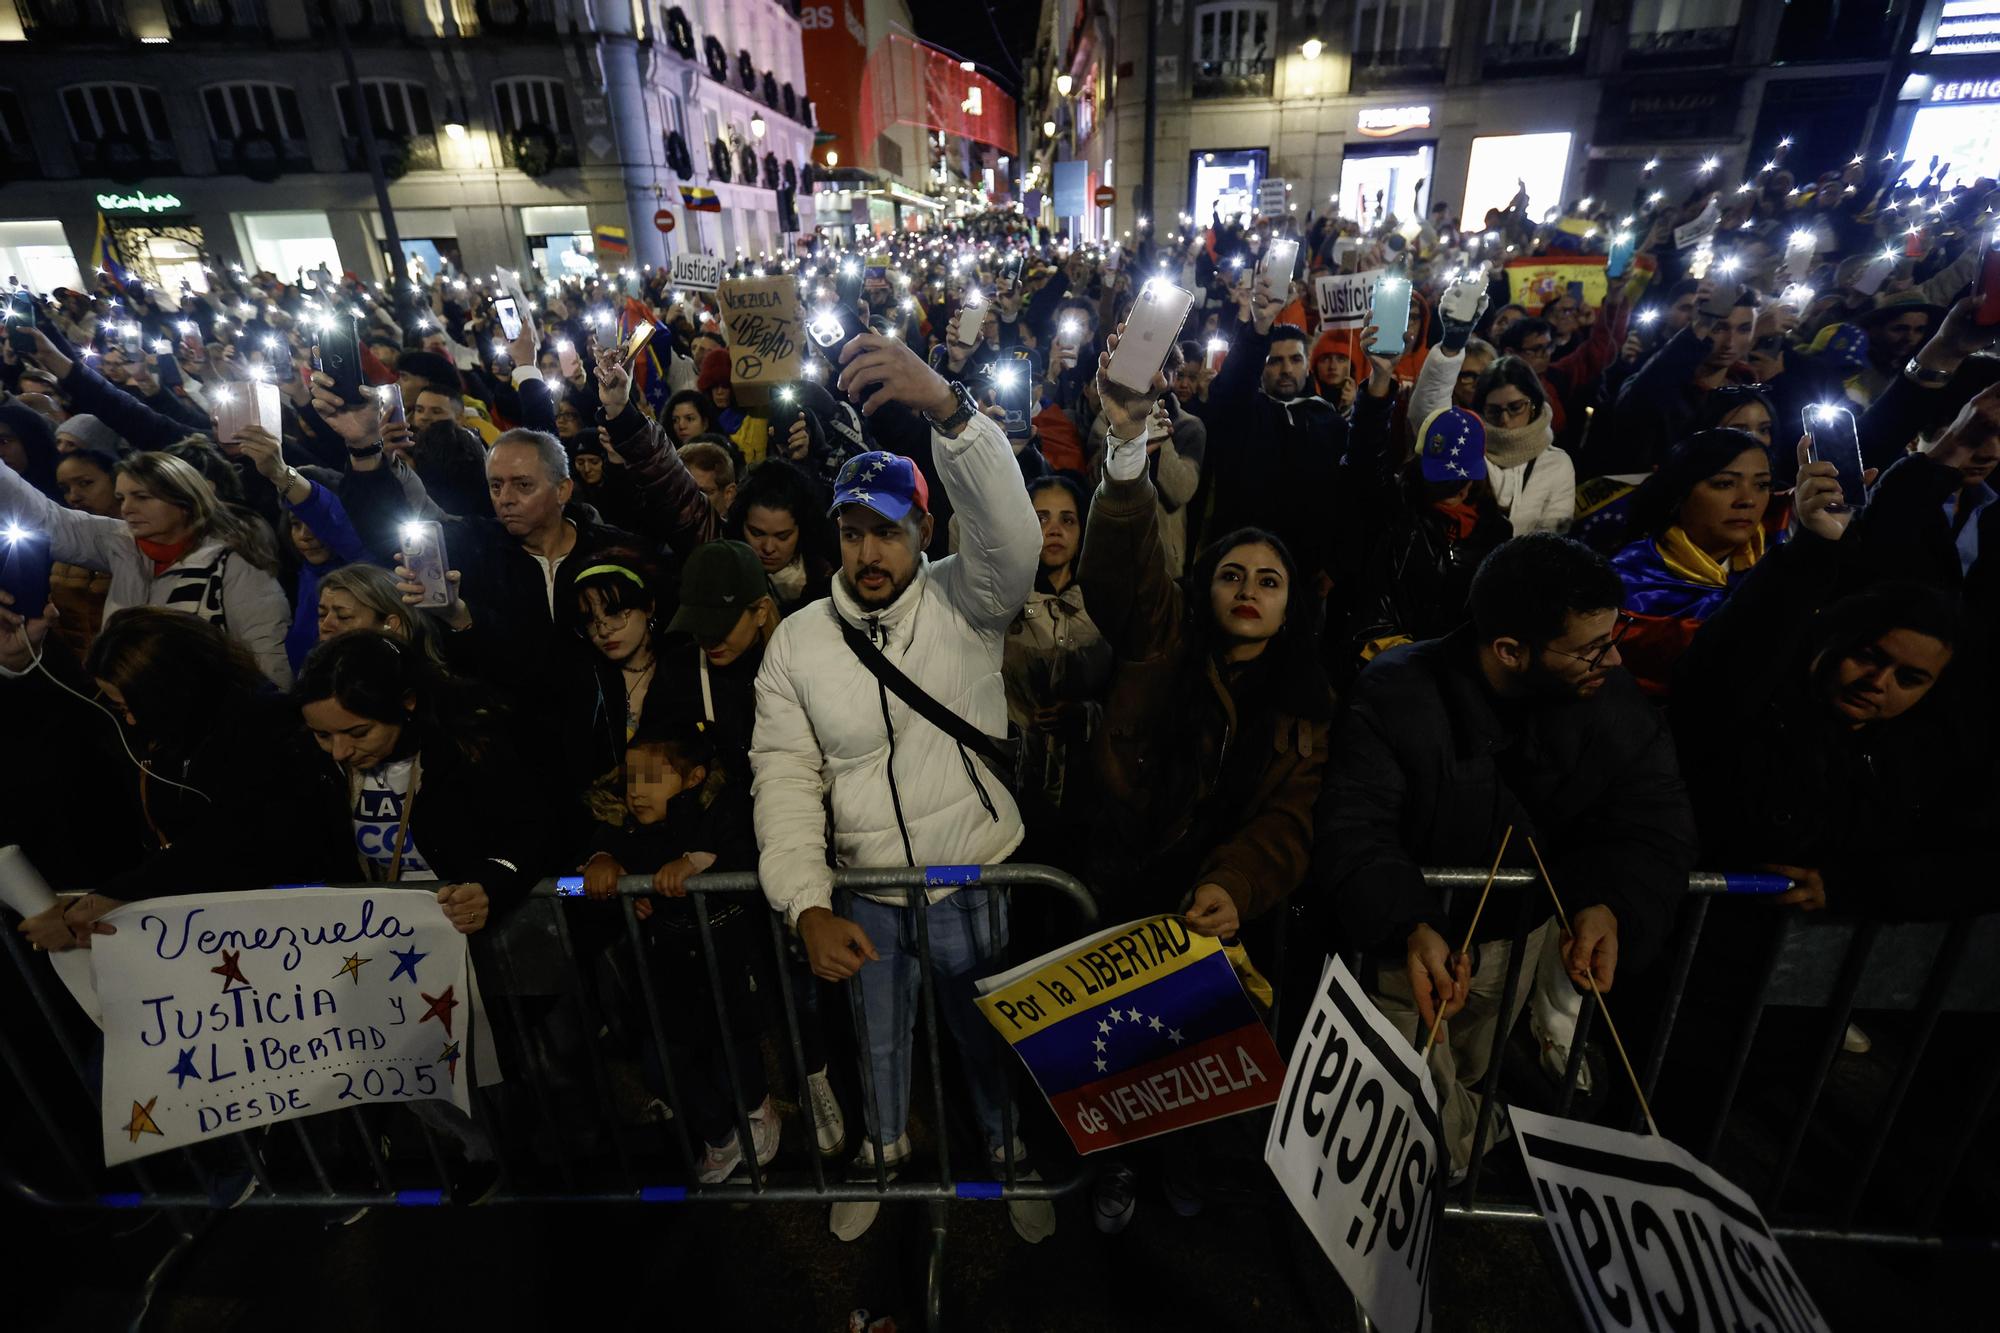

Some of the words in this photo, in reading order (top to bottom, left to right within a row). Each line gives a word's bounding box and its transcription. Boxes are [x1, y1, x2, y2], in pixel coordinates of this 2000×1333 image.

[673, 255, 720, 284] Justicia!
[359, 795, 398, 817] LA
[141, 899, 414, 971] Venezuela
[995, 992, 1046, 1029] Por
[1037, 979, 1076, 1007] la
[1065, 916, 1191, 995] LIBERTAD
[199, 1089, 311, 1133] DESDE
[332, 1065, 437, 1100] 2025
[1076, 1101, 1109, 1135] de
[1100, 1045, 1267, 1126] VENEZUELA
